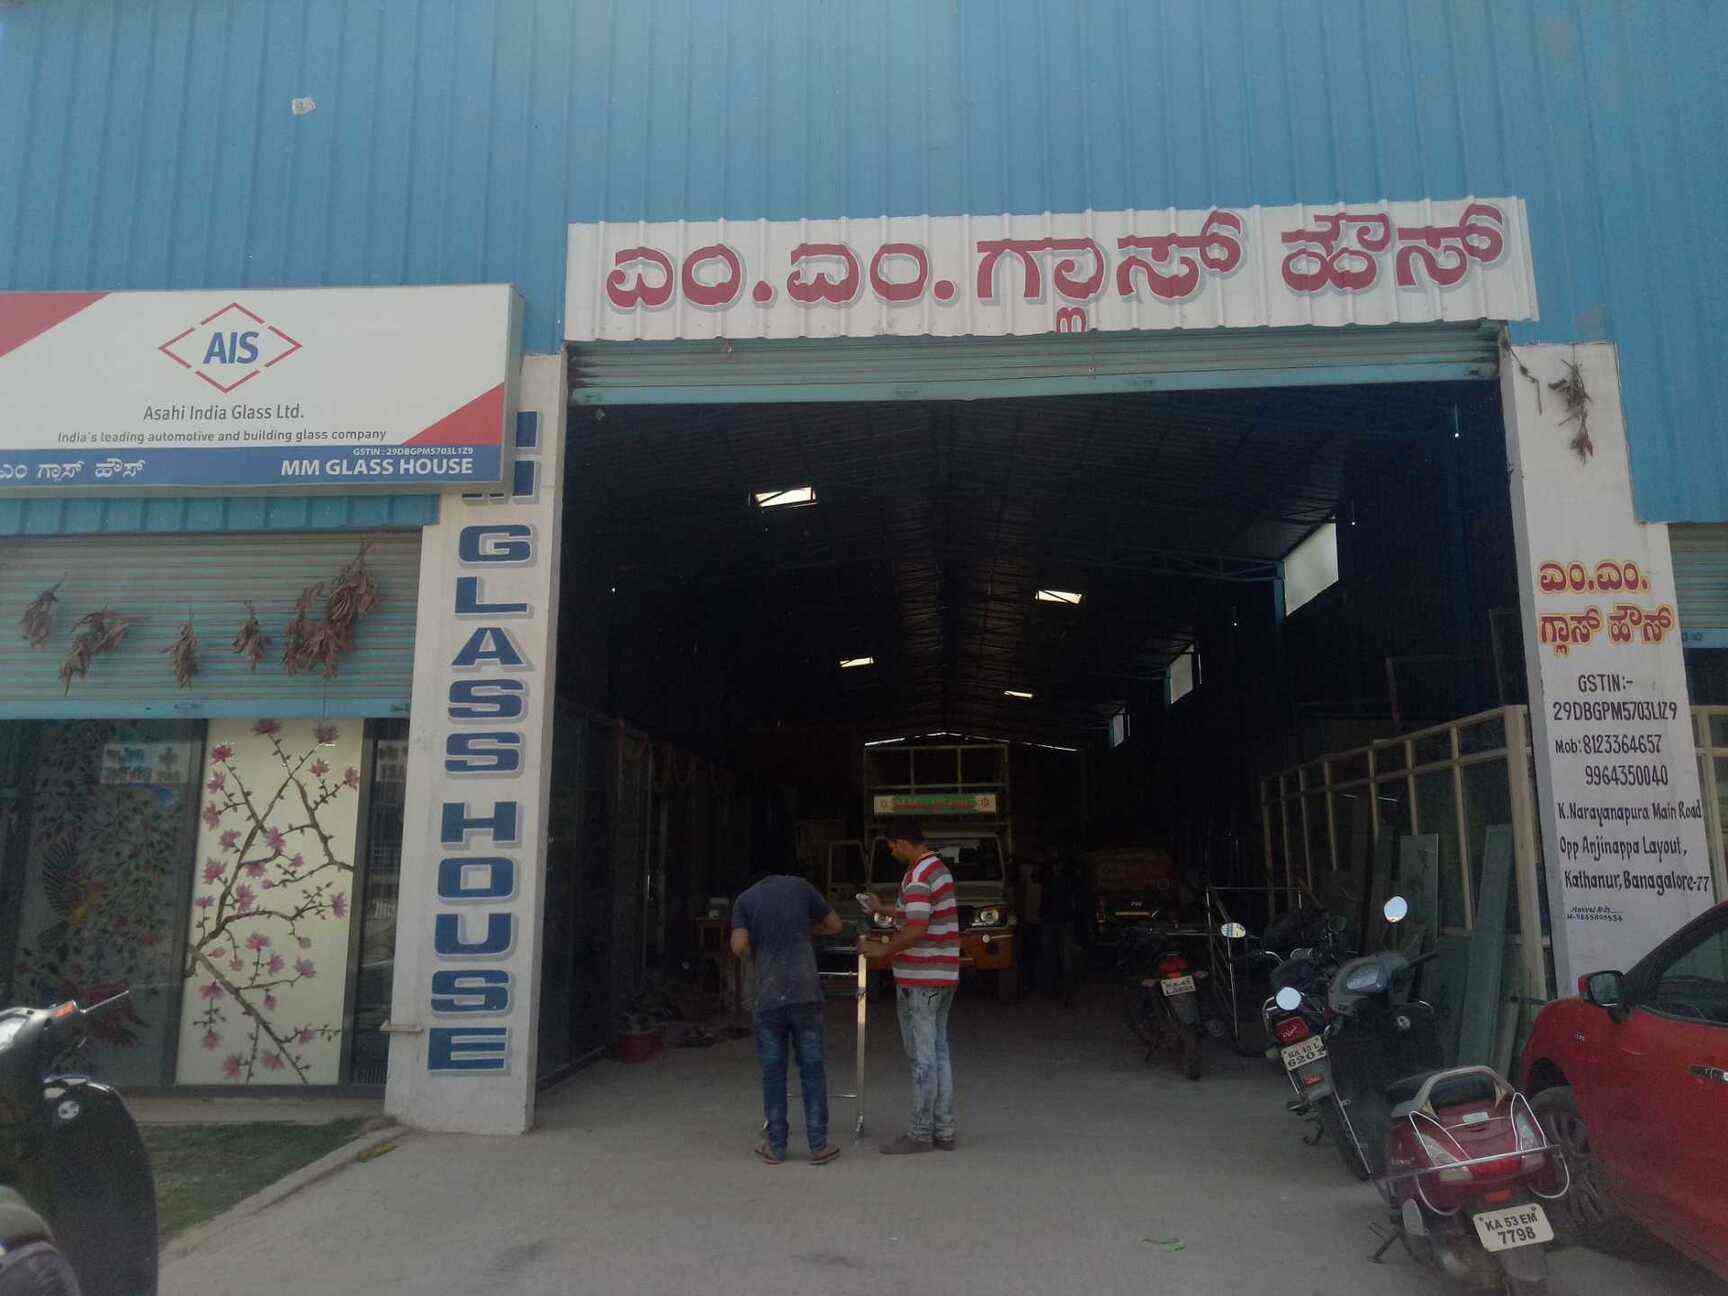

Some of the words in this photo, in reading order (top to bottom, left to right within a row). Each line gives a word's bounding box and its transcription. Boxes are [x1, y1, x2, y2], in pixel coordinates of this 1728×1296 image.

[203, 331, 260, 364] AIS
[143, 405, 185, 420] Asahi
[190, 405, 226, 420] India
[231, 404, 272, 419] Glass
[276, 403, 304, 419] Ltd.
[58, 432, 97, 443] India's
[101, 432, 144, 445] leading
[148, 431, 215, 442] automotive
[217, 431, 240, 441] and
[243, 430, 292, 442] building
[296, 430, 328, 442] glass
[331, 430, 386, 442] company
[281, 459, 320, 476] MM
[325, 459, 394, 475] GLASS
[400, 458, 473, 474] HOUSE
[445, 524, 533, 773] GLASS
[1585, 765, 1669, 785] 9964350040
[1652, 802, 1677, 820] Main
[1679, 800, 1702, 819] Road
[1560, 835, 1579, 859] Opp
[1582, 835, 1640, 861] Anjinappa
[427, 801, 518, 1071] HOUSE
[1485, 1219, 1503, 1232] KA
[1504, 1215, 1519, 1228] 53
[1520, 1212, 1538, 1224] EM
[1498, 1226, 1535, 1244] 7798
